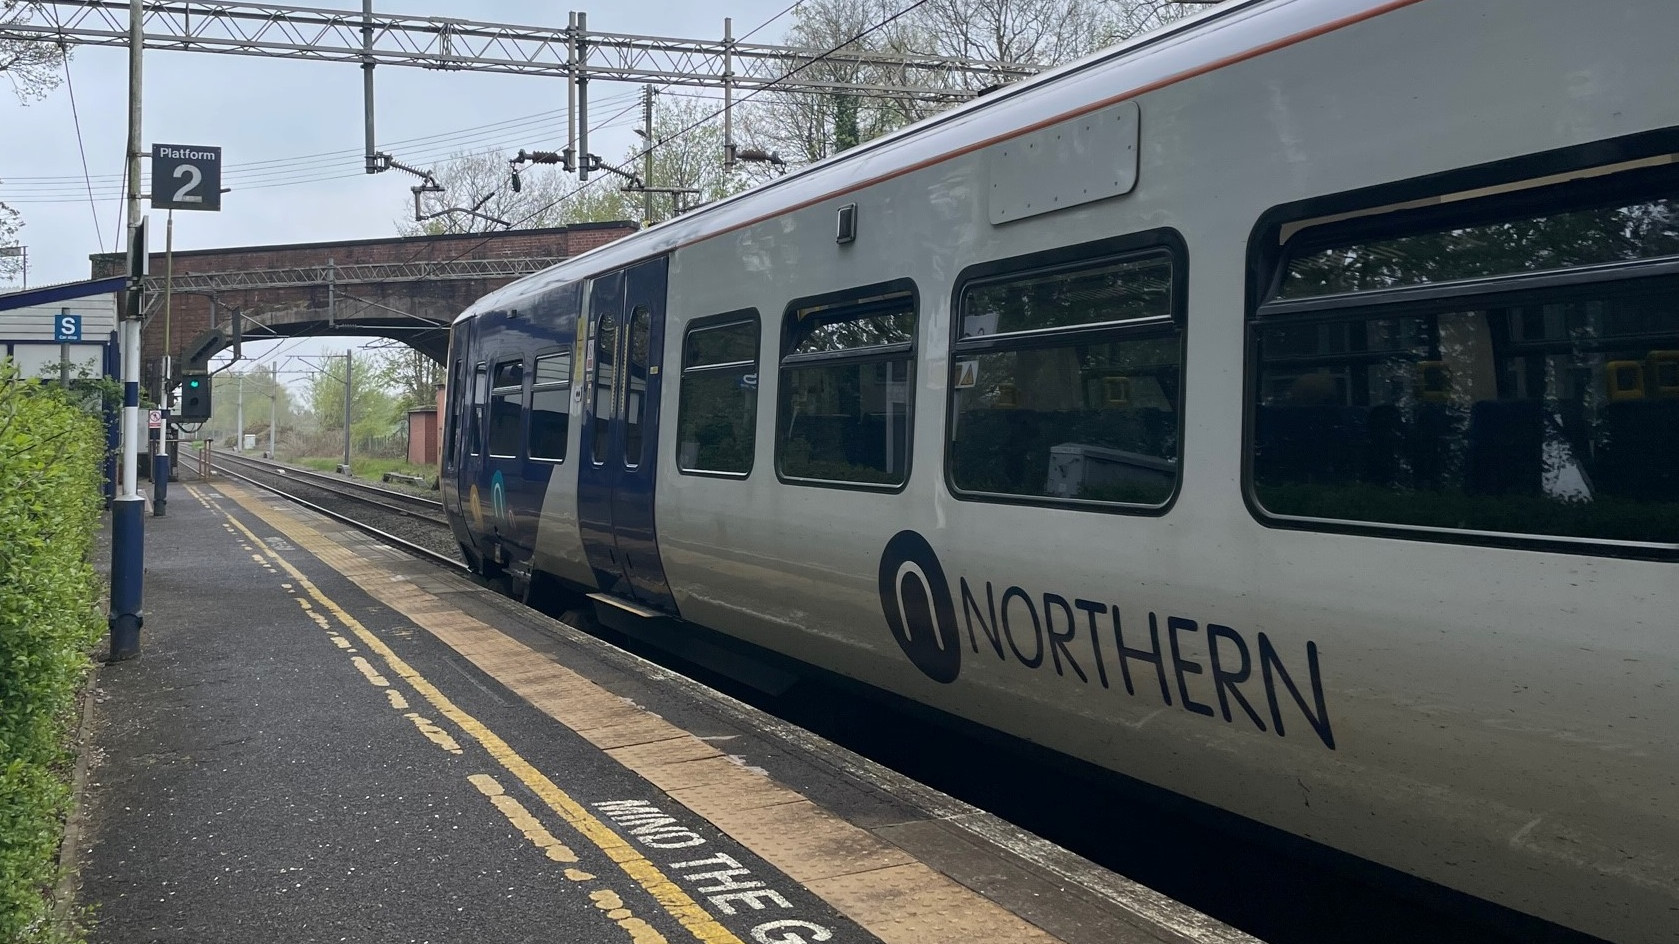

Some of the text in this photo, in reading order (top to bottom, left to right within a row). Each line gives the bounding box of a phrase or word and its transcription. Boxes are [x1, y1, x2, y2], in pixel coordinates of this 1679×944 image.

[160, 147, 215, 160] Platform
[172, 164, 203, 203] 2
[61, 317, 76, 335] S
[960, 576, 1336, 751] NORTHERN
[591, 799, 707, 849] MIND
[669, 852, 794, 911] THE
